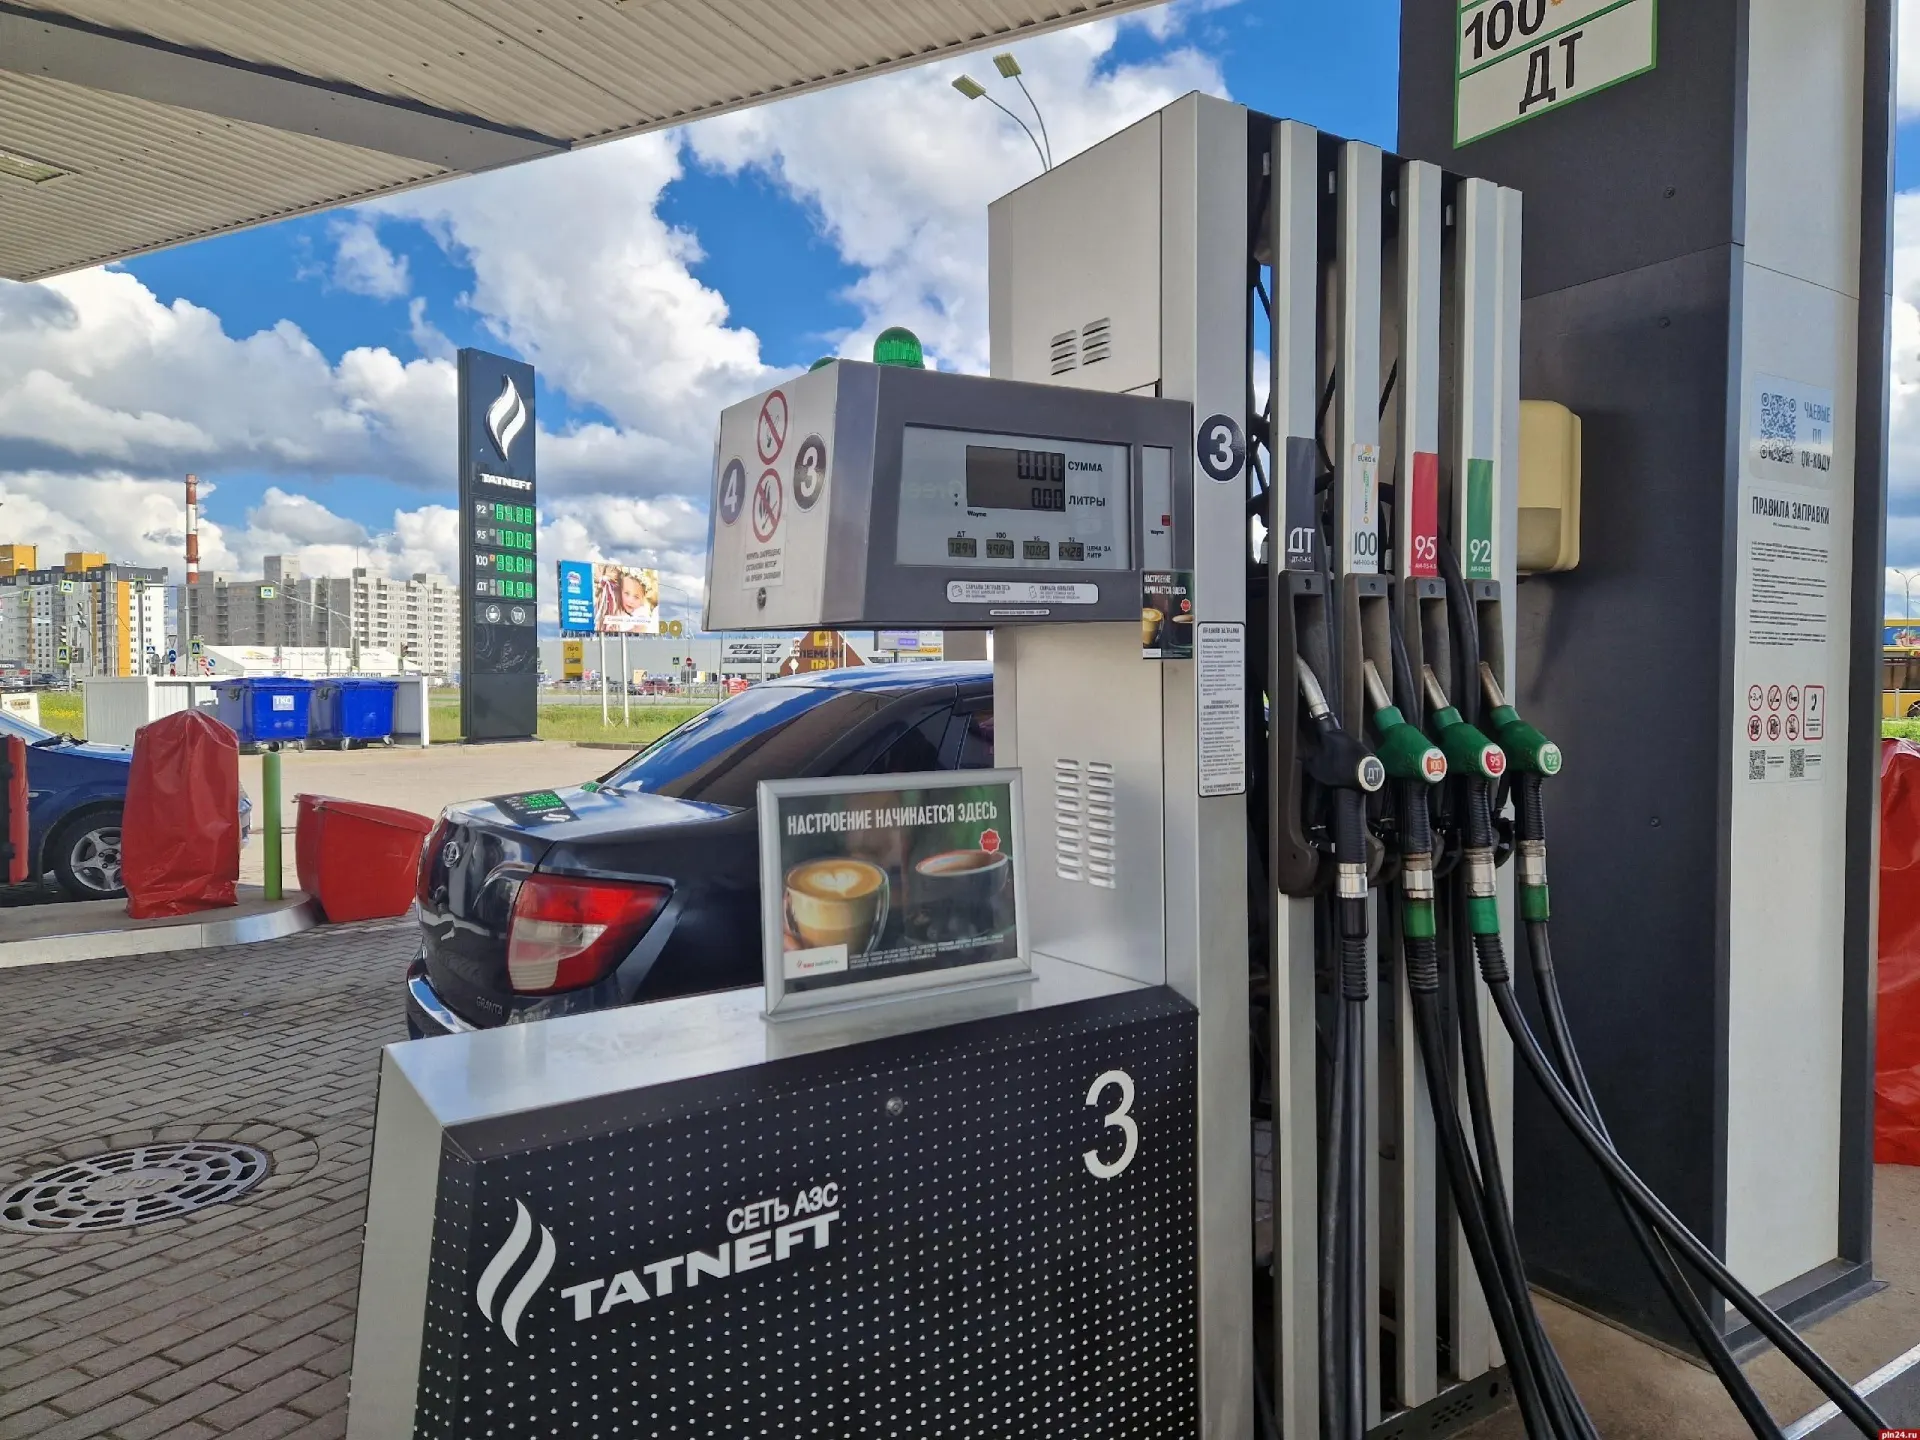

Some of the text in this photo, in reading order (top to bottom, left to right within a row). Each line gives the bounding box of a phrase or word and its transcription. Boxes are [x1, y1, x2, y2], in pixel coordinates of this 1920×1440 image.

[1464, 0, 1547, 60] 100
[1518, 30, 1584, 115] ДТ
[1209, 425, 1234, 471] 3
[800, 446, 818, 498] 3
[1067, 460, 1103, 473] СУММА
[480, 473, 533, 491] TATNEFT
[724, 468, 739, 513] 4
[476, 504, 487, 514] 92
[1068, 495, 1106, 507] ЛИТРЫ
[1752, 496, 1830, 525] ПРАВИЛА ЗАПРАВКИ
[476, 530, 487, 541] 95
[956, 530, 967, 539] ДТ
[1287, 526, 1316, 554] ДТ
[1354, 531, 1378, 556] 100
[1414, 535, 1438, 560] 95
[1469, 538, 1491, 563] 92
[474, 554, 489, 567] 100
[476, 581, 488, 593] ДТ
[1430, 760, 1443, 771] 100
[1489, 755, 1502, 767] 95
[1547, 754, 1558, 766] 92
[1366, 767, 1380, 782] ДТ
[787, 801, 998, 836] НАСТРОЕНИЕ НАЧИНАЕТСЯ ЗДЕСЬ
[476, 996, 503, 1017] GRANTA
[1082, 1069, 1139, 1179] 3
[725, 1181, 839, 1235] СЕТЬ АЗС
[560, 1210, 840, 1322] TATNEFT
